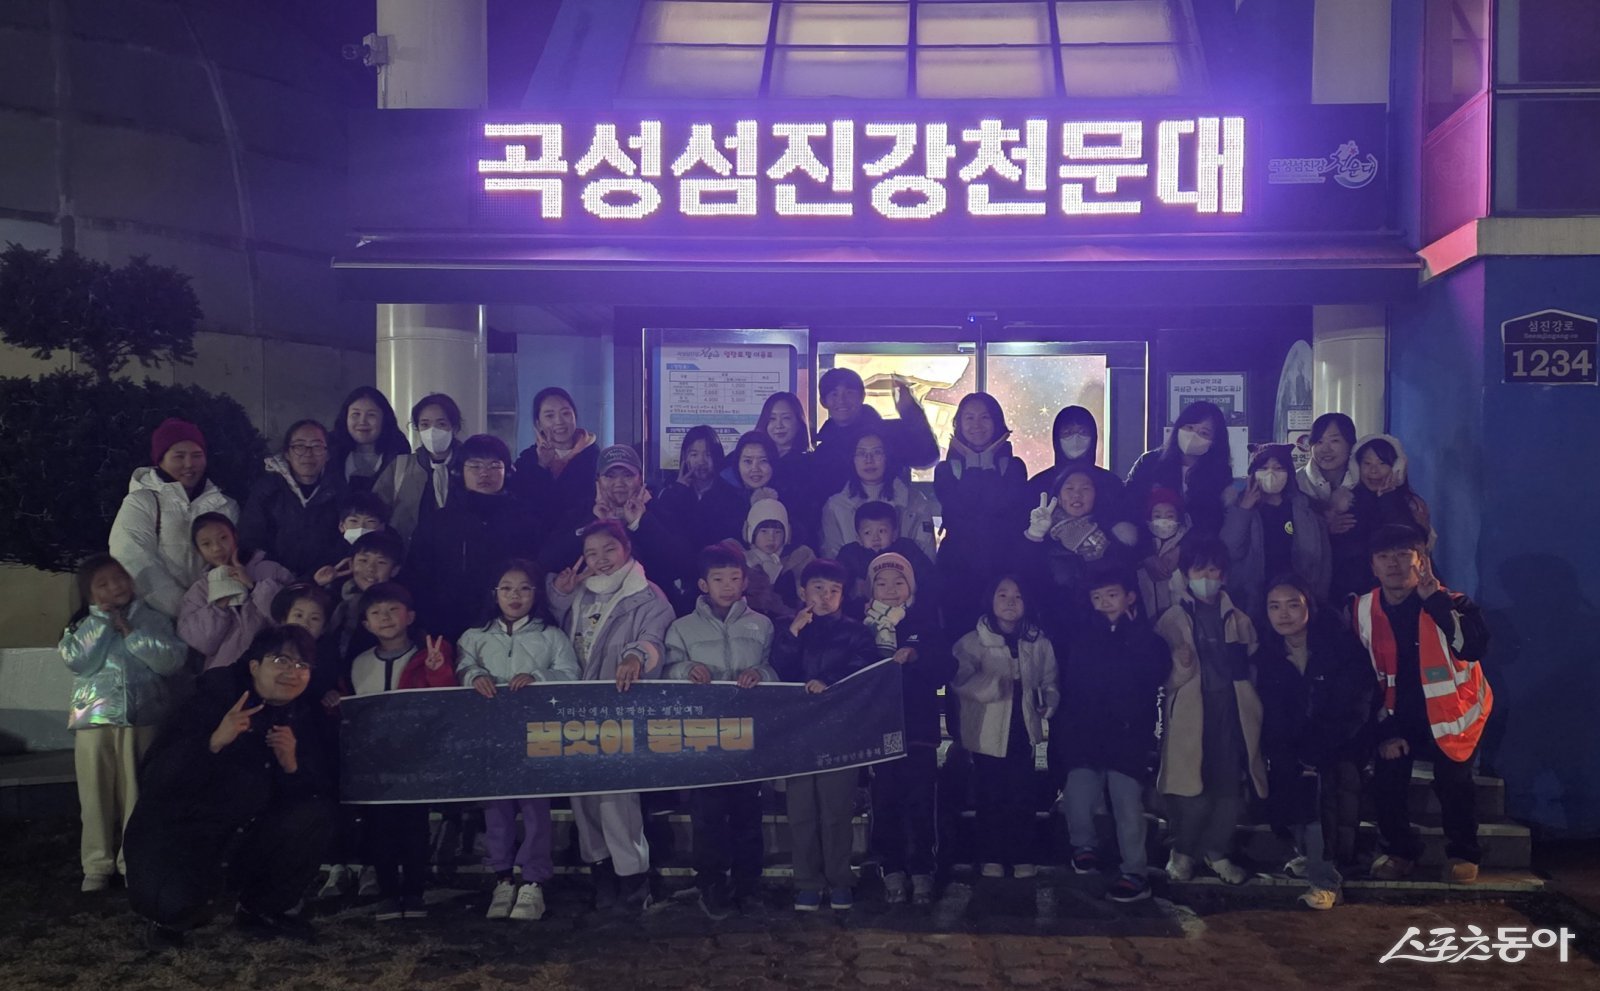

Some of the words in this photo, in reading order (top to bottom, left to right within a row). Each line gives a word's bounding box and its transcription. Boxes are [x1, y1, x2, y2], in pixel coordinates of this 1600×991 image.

[477, 117, 1246, 219] 곡성섬진강천문대
[1269, 159, 1326, 173] 곡성섬진강
[1528, 320, 1575, 333] 섬진강로
[1512, 349, 1593, 377] 1234
[556, 706, 609, 718] 지리산에서
